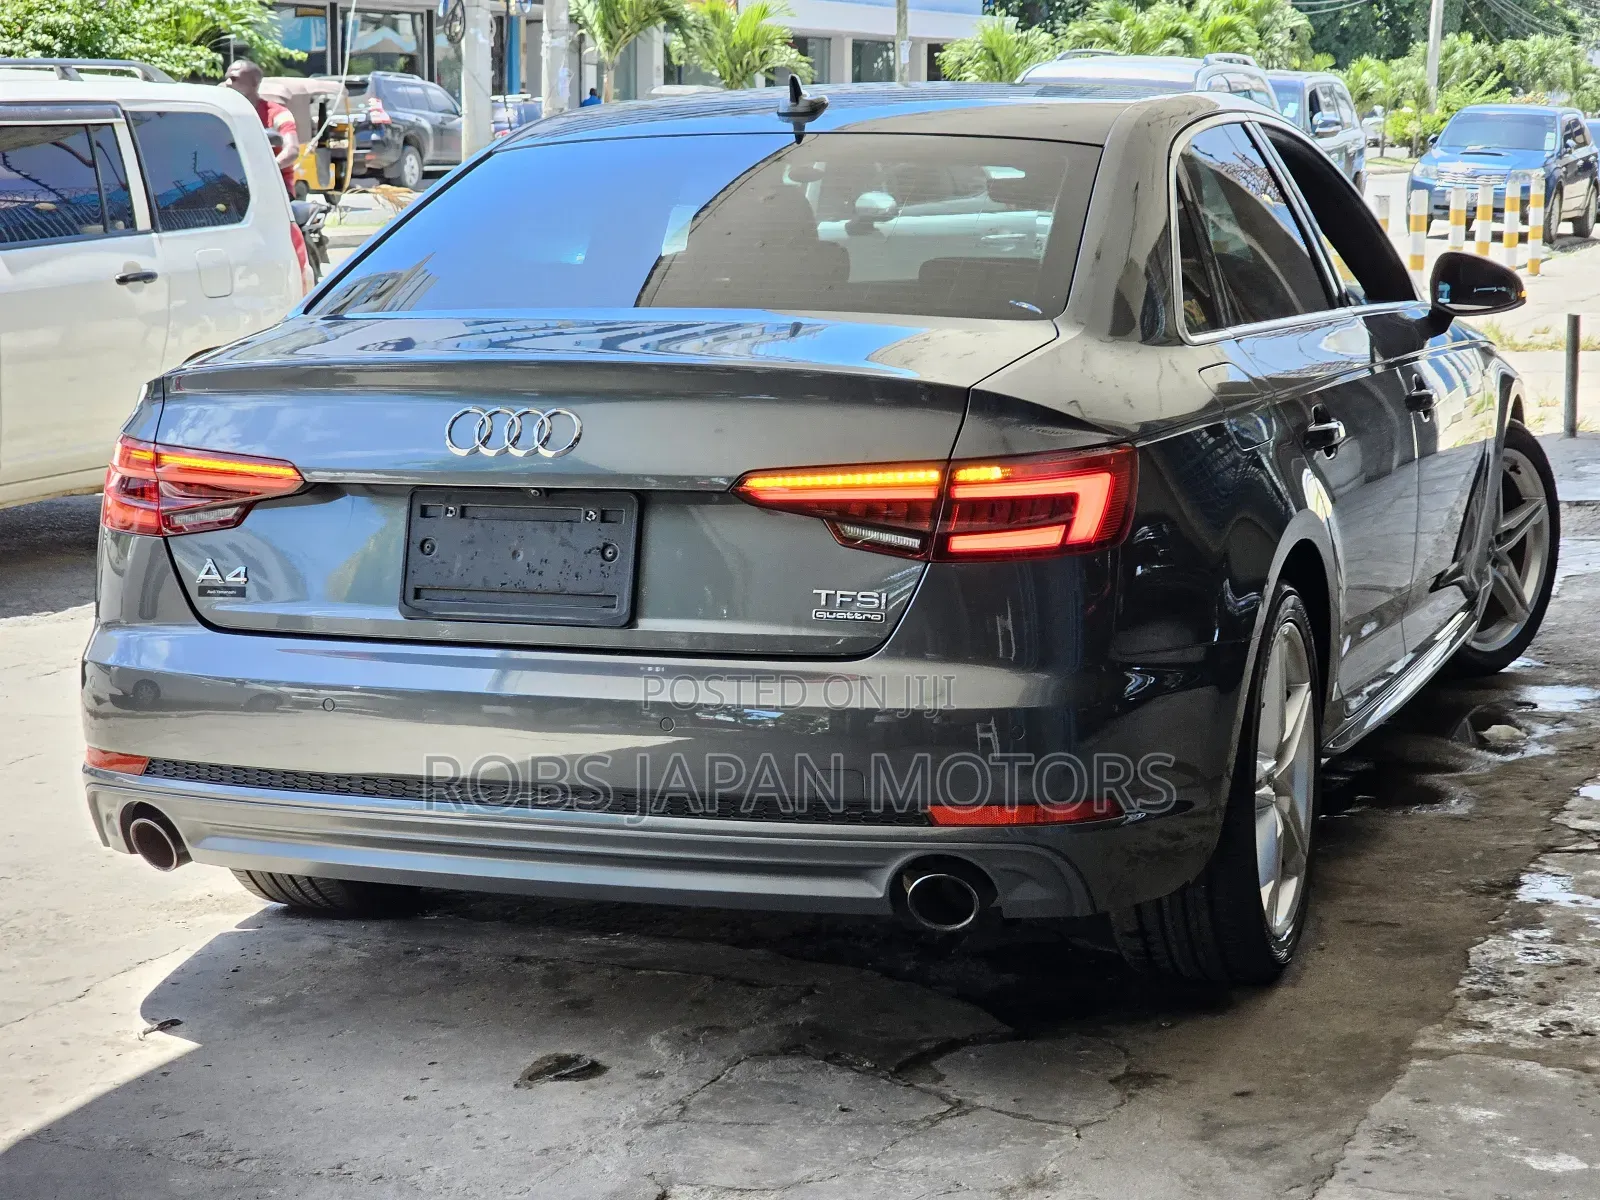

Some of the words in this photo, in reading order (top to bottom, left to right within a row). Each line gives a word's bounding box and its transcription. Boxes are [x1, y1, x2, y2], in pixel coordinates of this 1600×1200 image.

[196, 558, 248, 584] A4
[812, 589, 887, 610] TFSI
[815, 610, 882, 621] quattro
